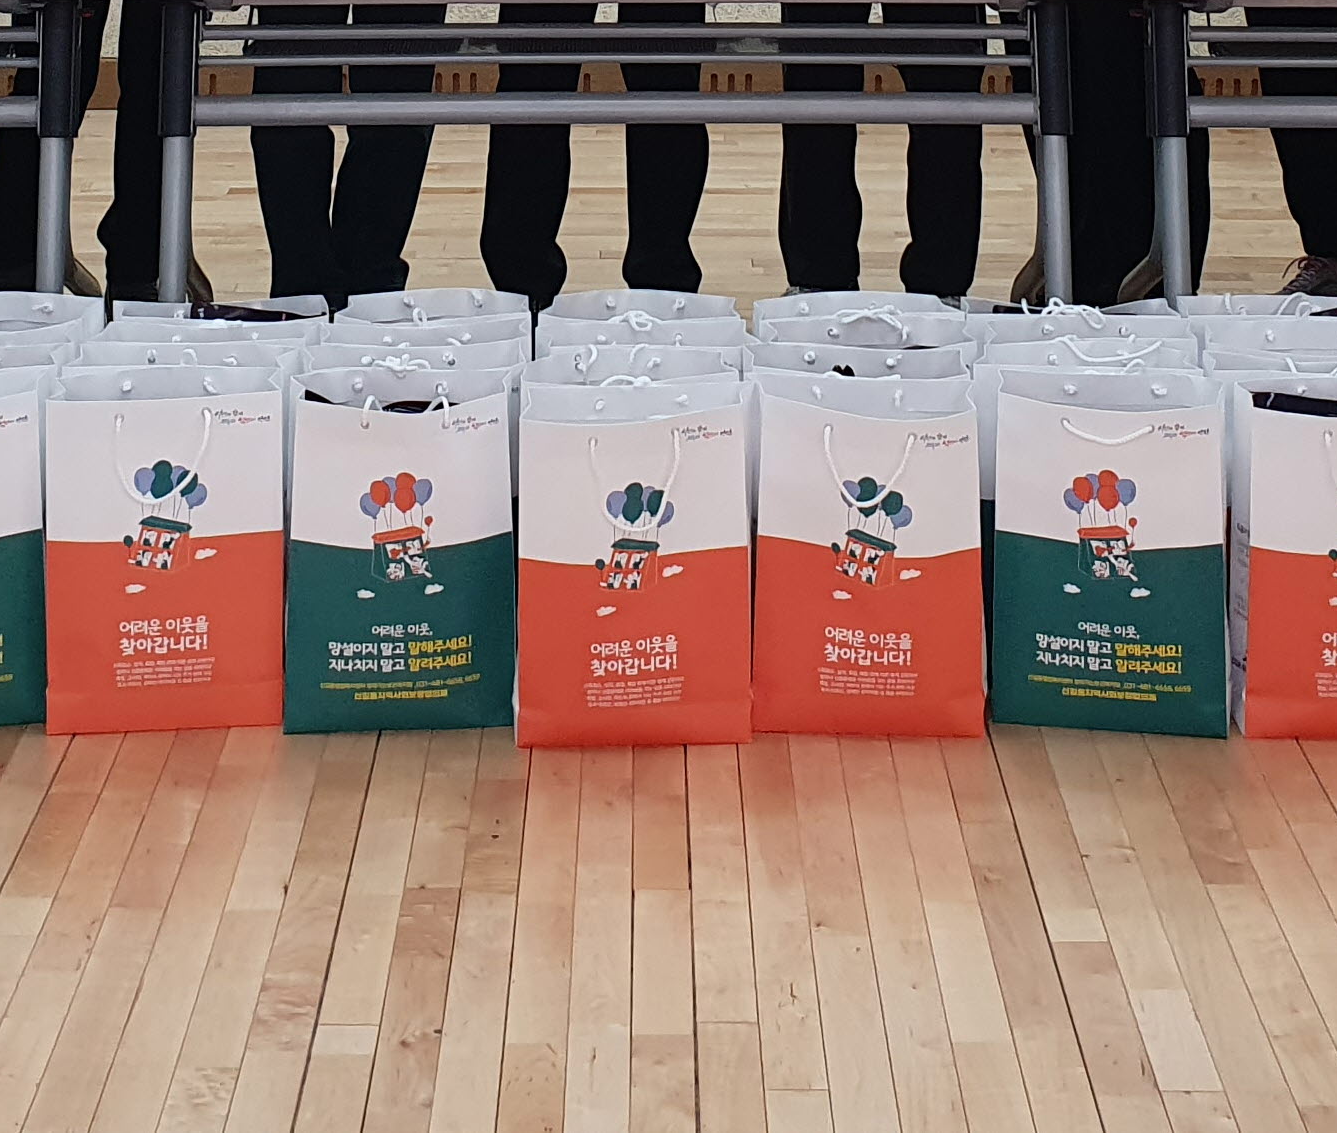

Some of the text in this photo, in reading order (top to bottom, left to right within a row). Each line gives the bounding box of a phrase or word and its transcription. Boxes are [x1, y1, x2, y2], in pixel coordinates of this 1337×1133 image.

[119, 615, 209, 636] 어려운 이웃을
[119, 634, 208, 656] 찾아갑니다!
[329, 642, 377, 656] 망설이지
[408, 635, 472, 655] 말해주세요!
[591, 635, 678, 657] 어려운 이웃을
[825, 626, 912, 649] 어려운 이웃을
[1036, 633, 1084, 652] 망설이지
[1115, 643, 1182, 657] 말해주세요!
[329, 659, 377, 672] 지나치지
[408, 652, 472, 671] 알려주세요!
[591, 654, 677, 677] 찾아갑니다!
[824, 643, 911, 666] 찾아갑니다!
[1036, 651, 1084, 669] 지나치지
[1115, 659, 1182, 673] 알려주세요!
